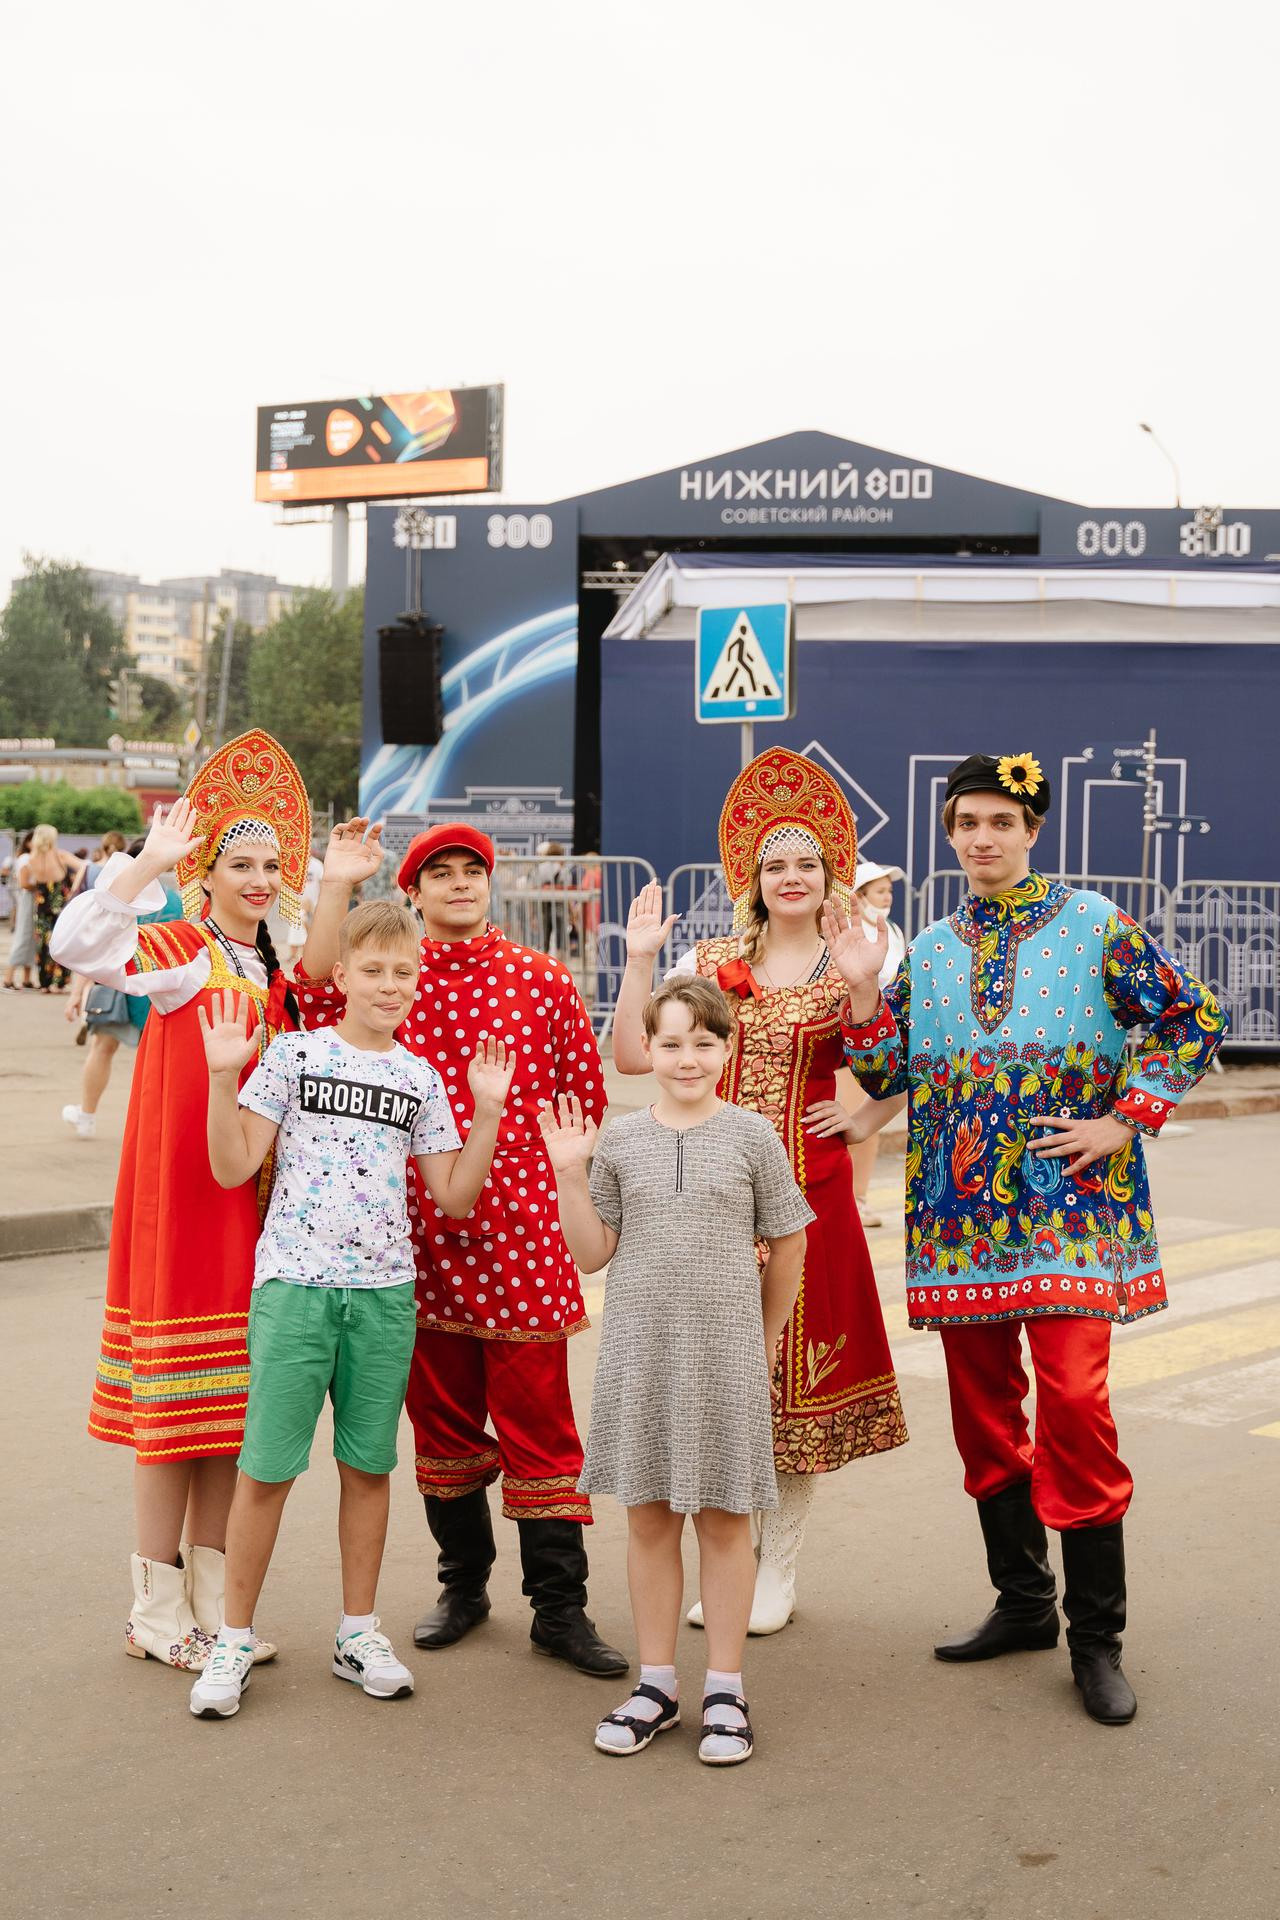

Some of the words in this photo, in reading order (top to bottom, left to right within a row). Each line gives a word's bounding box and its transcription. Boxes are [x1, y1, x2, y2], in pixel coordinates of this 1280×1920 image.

[680, 462, 859, 501] НИЖНИЙ
[864, 467, 933, 501] 800
[487, 513, 553, 549] 800
[720, 504, 828, 524] СОВЕТСКИЙ
[831, 504, 894, 524] РАЙОН
[1076, 520, 1147, 557] 800
[304, 1080, 418, 1127] PROBLEM?
